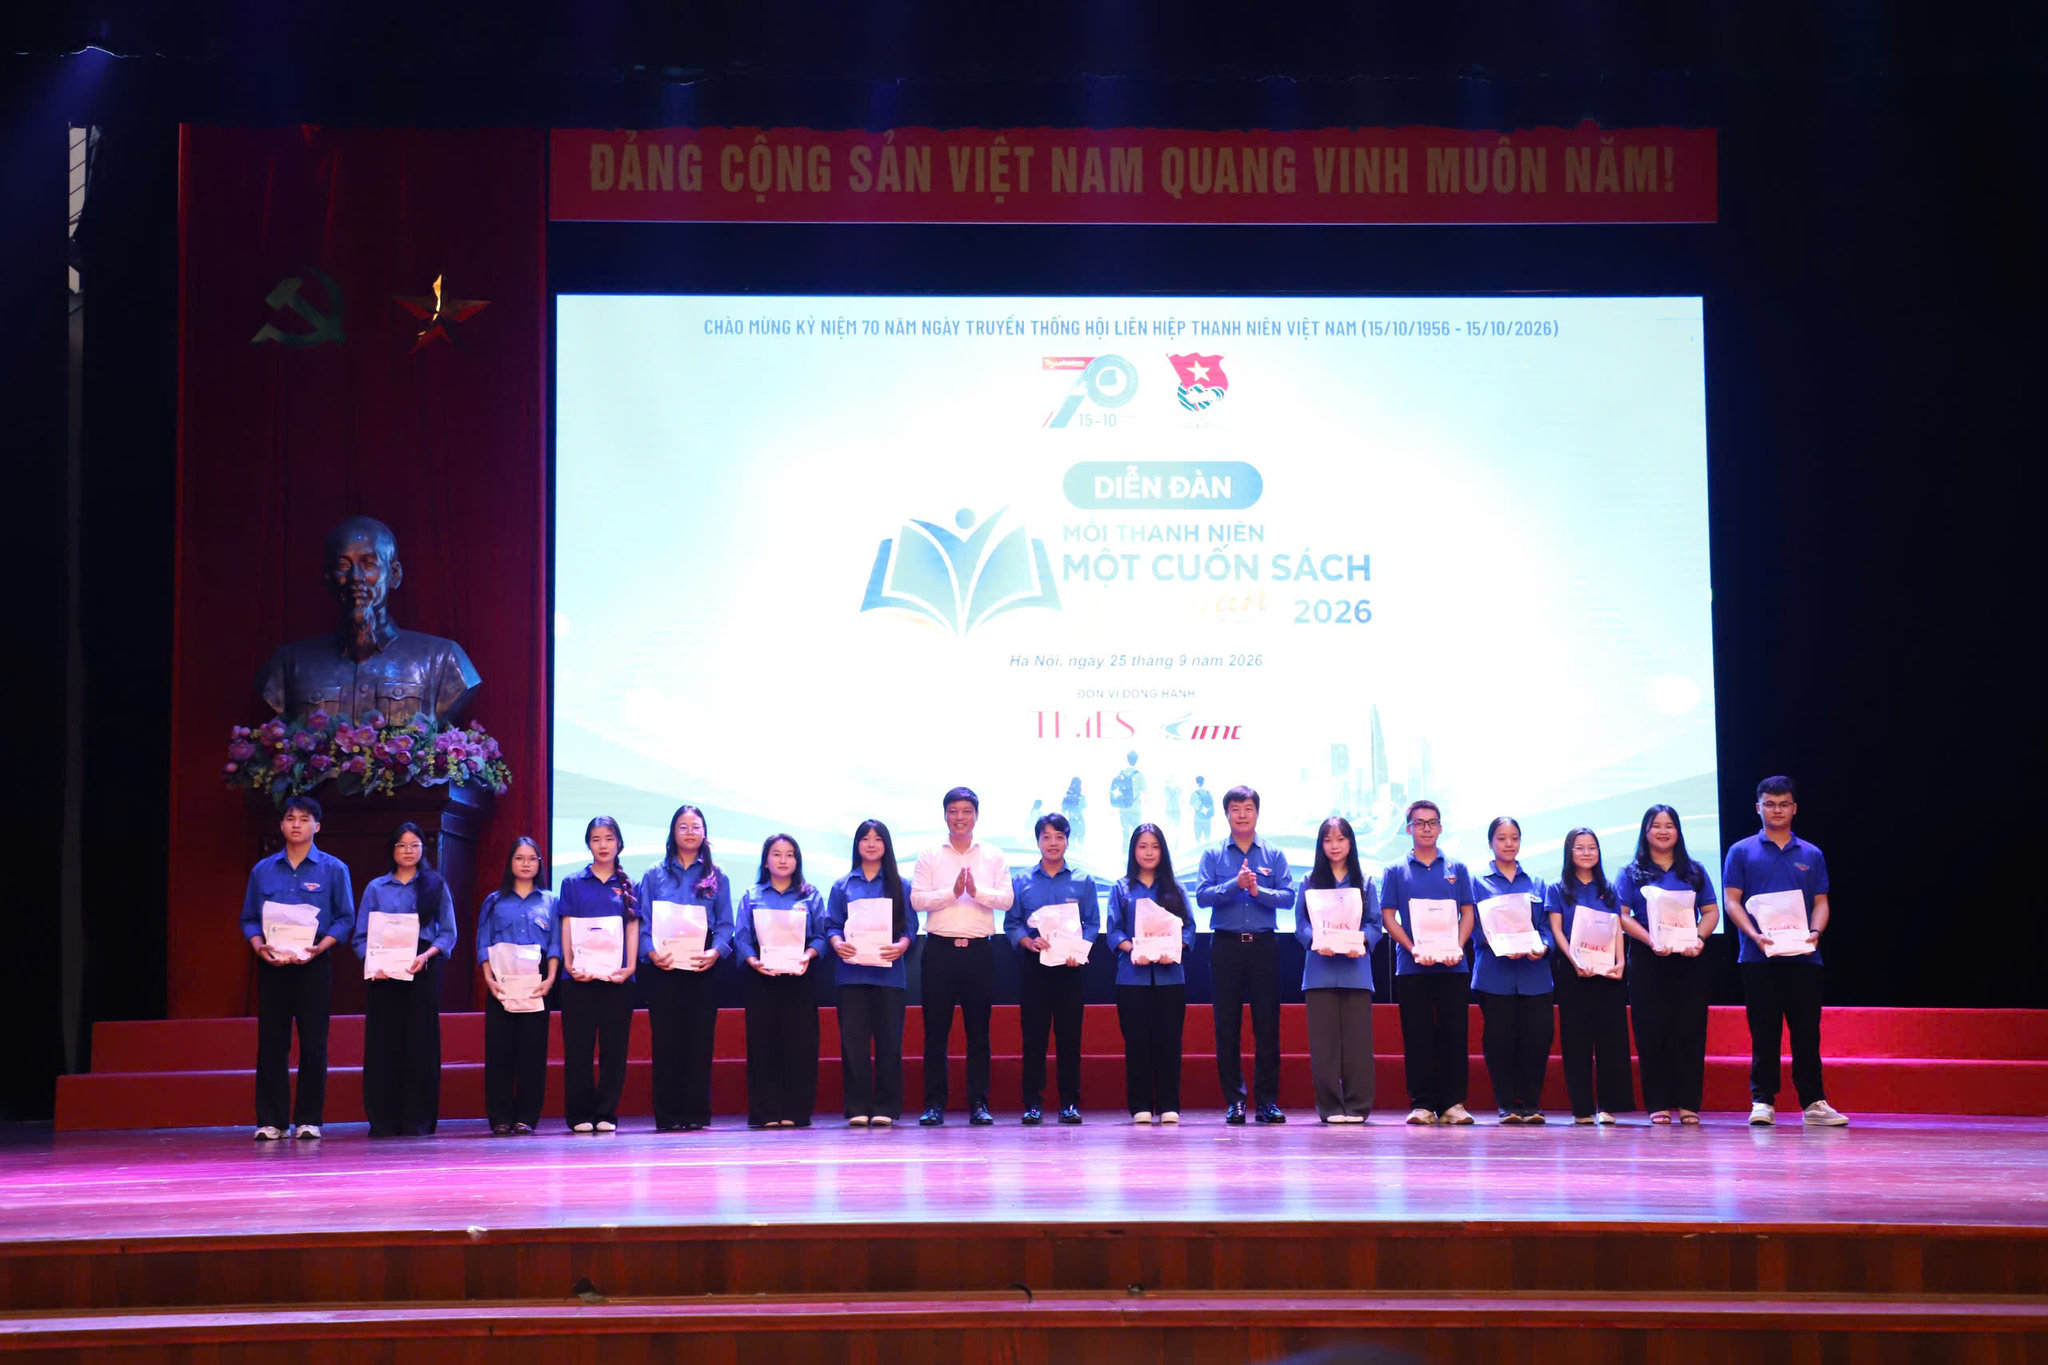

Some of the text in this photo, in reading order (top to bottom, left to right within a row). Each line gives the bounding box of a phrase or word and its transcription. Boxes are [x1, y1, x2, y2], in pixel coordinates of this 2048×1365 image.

[590, 129, 1674, 204] ĐẢNG CỘNG SẢN VIỆT NAM QUANG VINH MUÔN NĂM!
[704, 316, 743, 335] CHÀO
[749, 316, 791, 335] MỪNG
[796, 315, 815, 335] KỶ
[821, 316, 857, 340] NIỆM
[862, 320, 880, 336] 70
[885, 318, 916, 336] NĂM
[922, 317, 960, 336] NGÀY
[965, 314, 1025, 336] TRUYỀN
[1030, 315, 1080, 336] THỐNG
[1085, 317, 1109, 340] HỘI
[1115, 317, 1147, 336] LIÊN
[1153, 317, 1186, 340] HIỆP
[1191, 320, 1242, 336] THANH
[1247, 317, 1281, 336] NIÊN
[1287, 317, 1320, 340] VIỆT
[1325, 321, 1357, 336] NAM
[1361, 320, 1450, 338] (15/10/1956
[1466, 320, 1559, 338] 15/10/2026)
[1094, 465, 1231, 499] DIỄN ĐÀN
[1115, 524, 1200, 542] THANH
[1063, 544, 1371, 588] MỘT CUỐN SÁCH
[1294, 599, 1373, 624] 2026
[1110, 655, 1127, 667] 25
[1179, 655, 1187, 667] 9
[1229, 654, 1263, 667] 2026
